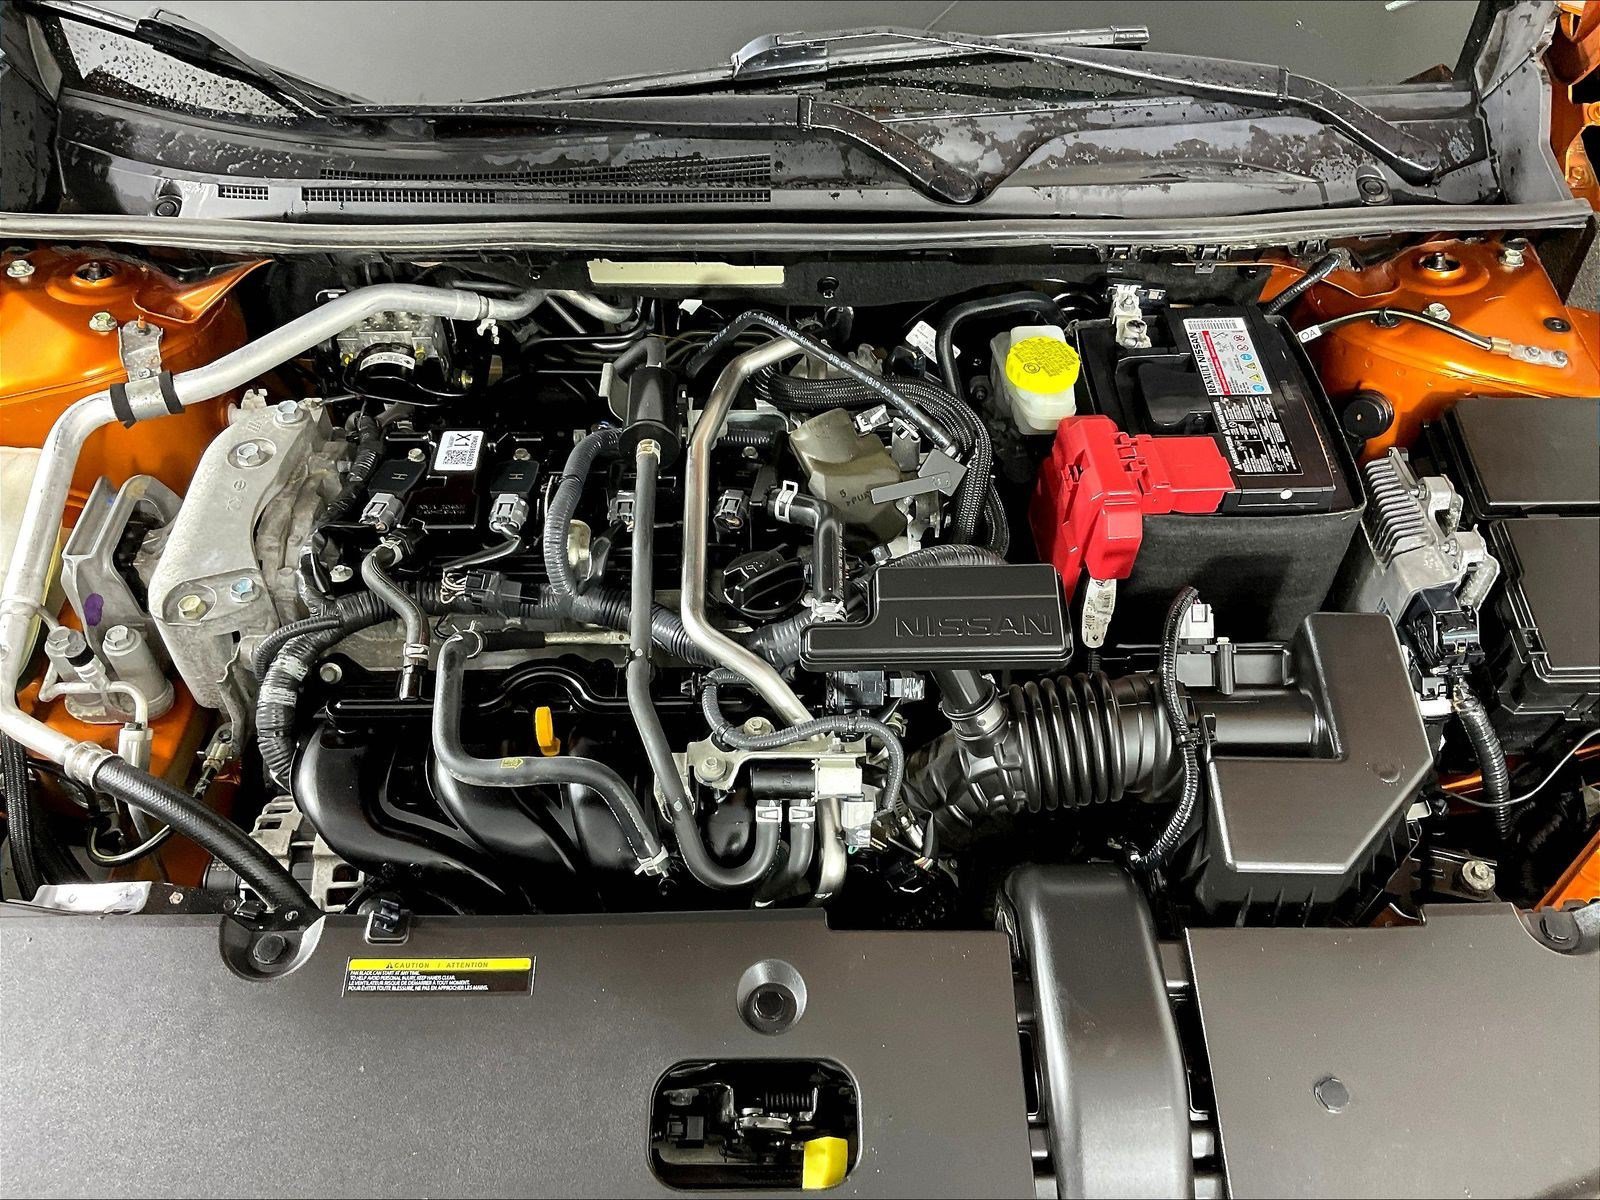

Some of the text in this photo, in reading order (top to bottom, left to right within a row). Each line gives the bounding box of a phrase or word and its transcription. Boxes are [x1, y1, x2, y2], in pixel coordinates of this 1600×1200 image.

[1188, 331, 1207, 363] NISSAN
[865, 375, 881, 389] 1519
[881, 385, 891, 397] DO
[1200, 364, 1218, 394] RENAULT
[453, 433, 472, 447] X1
[895, 614, 1053, 638] NISSAN
[446, 961, 489, 969] ATTENTION
